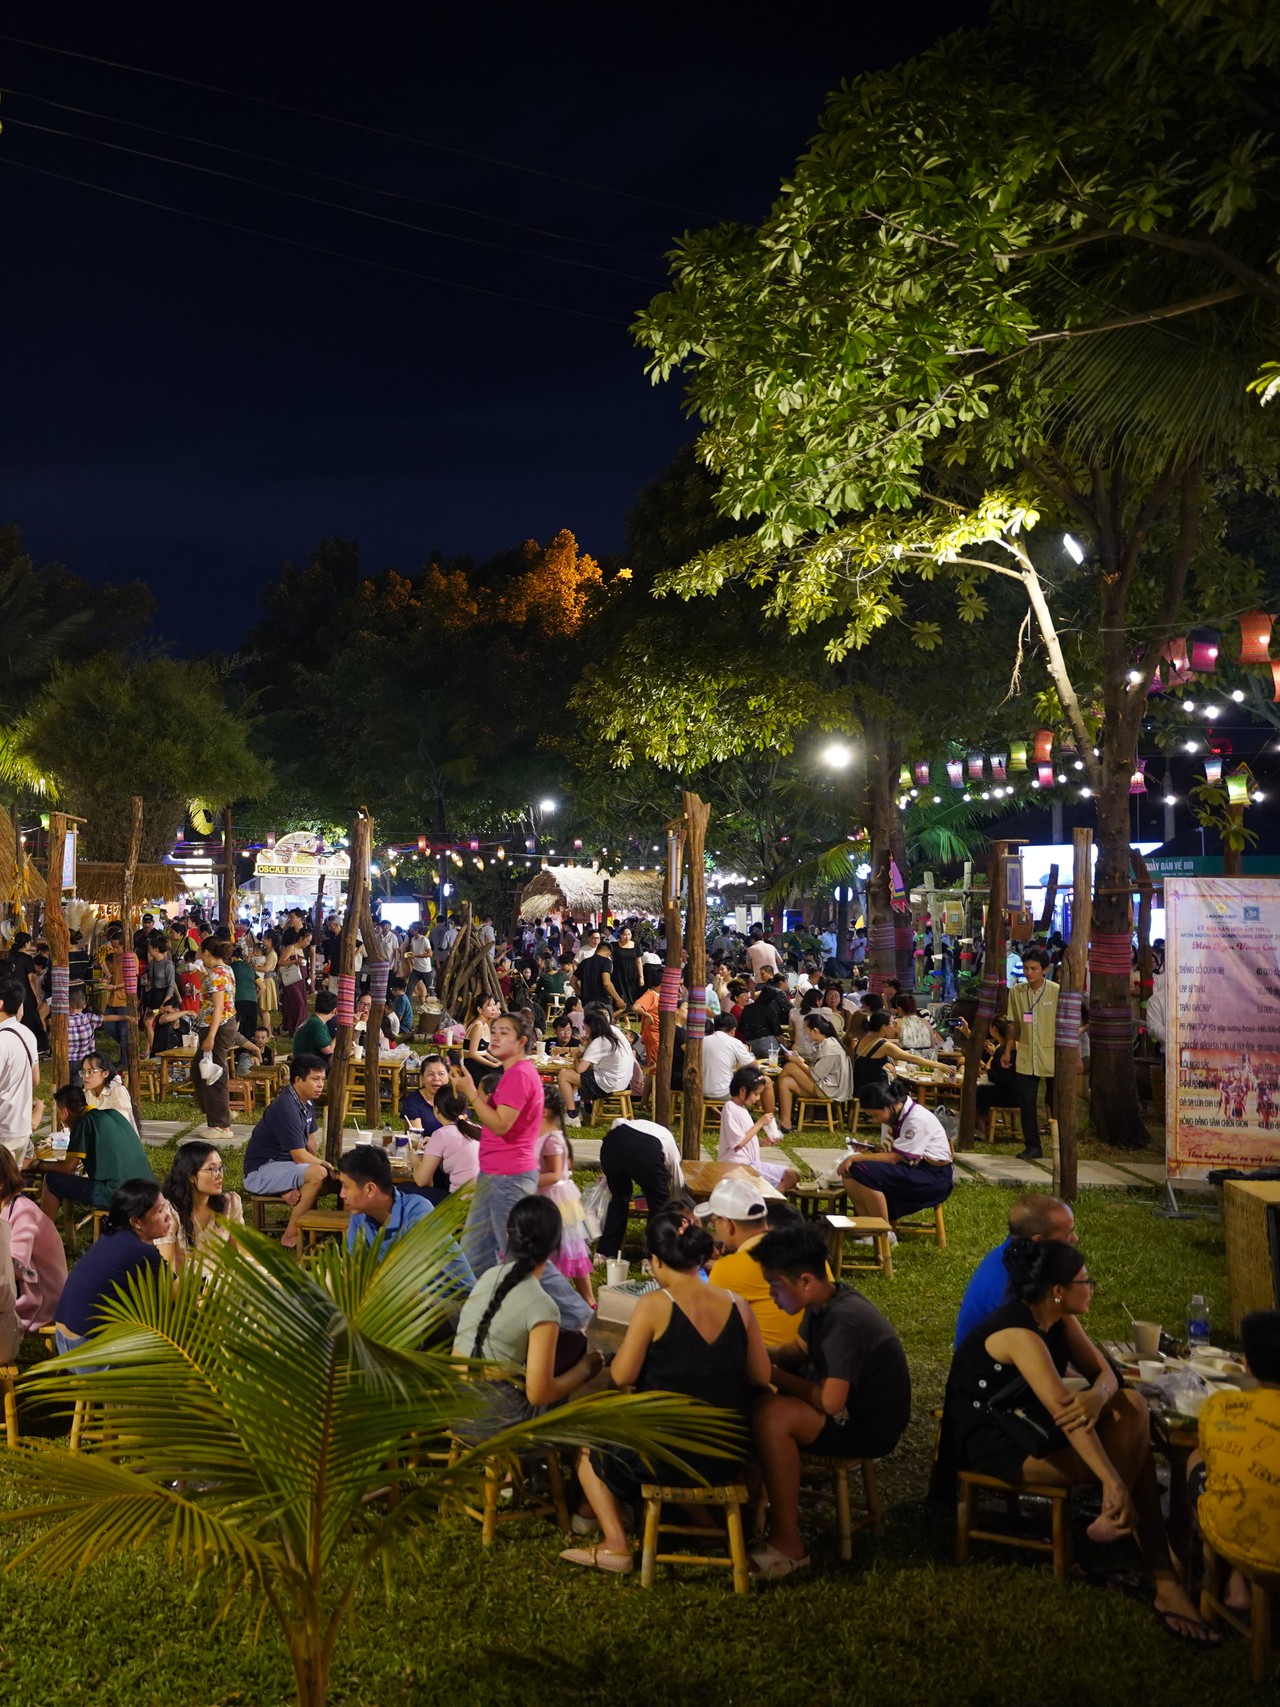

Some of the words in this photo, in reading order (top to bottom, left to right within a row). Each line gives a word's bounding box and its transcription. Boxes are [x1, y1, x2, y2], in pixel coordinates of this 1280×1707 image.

[1160, 860, 1174, 870] BÁN
[1174, 859, 1182, 870] VÉ
[258, 866, 285, 874] OSCAR
[288, 867, 318, 875] SAIGON
[321, 868, 349, 876] HOTEL
[1192, 942, 1211, 950] Món
[1262, 942, 1277, 951] Cao
